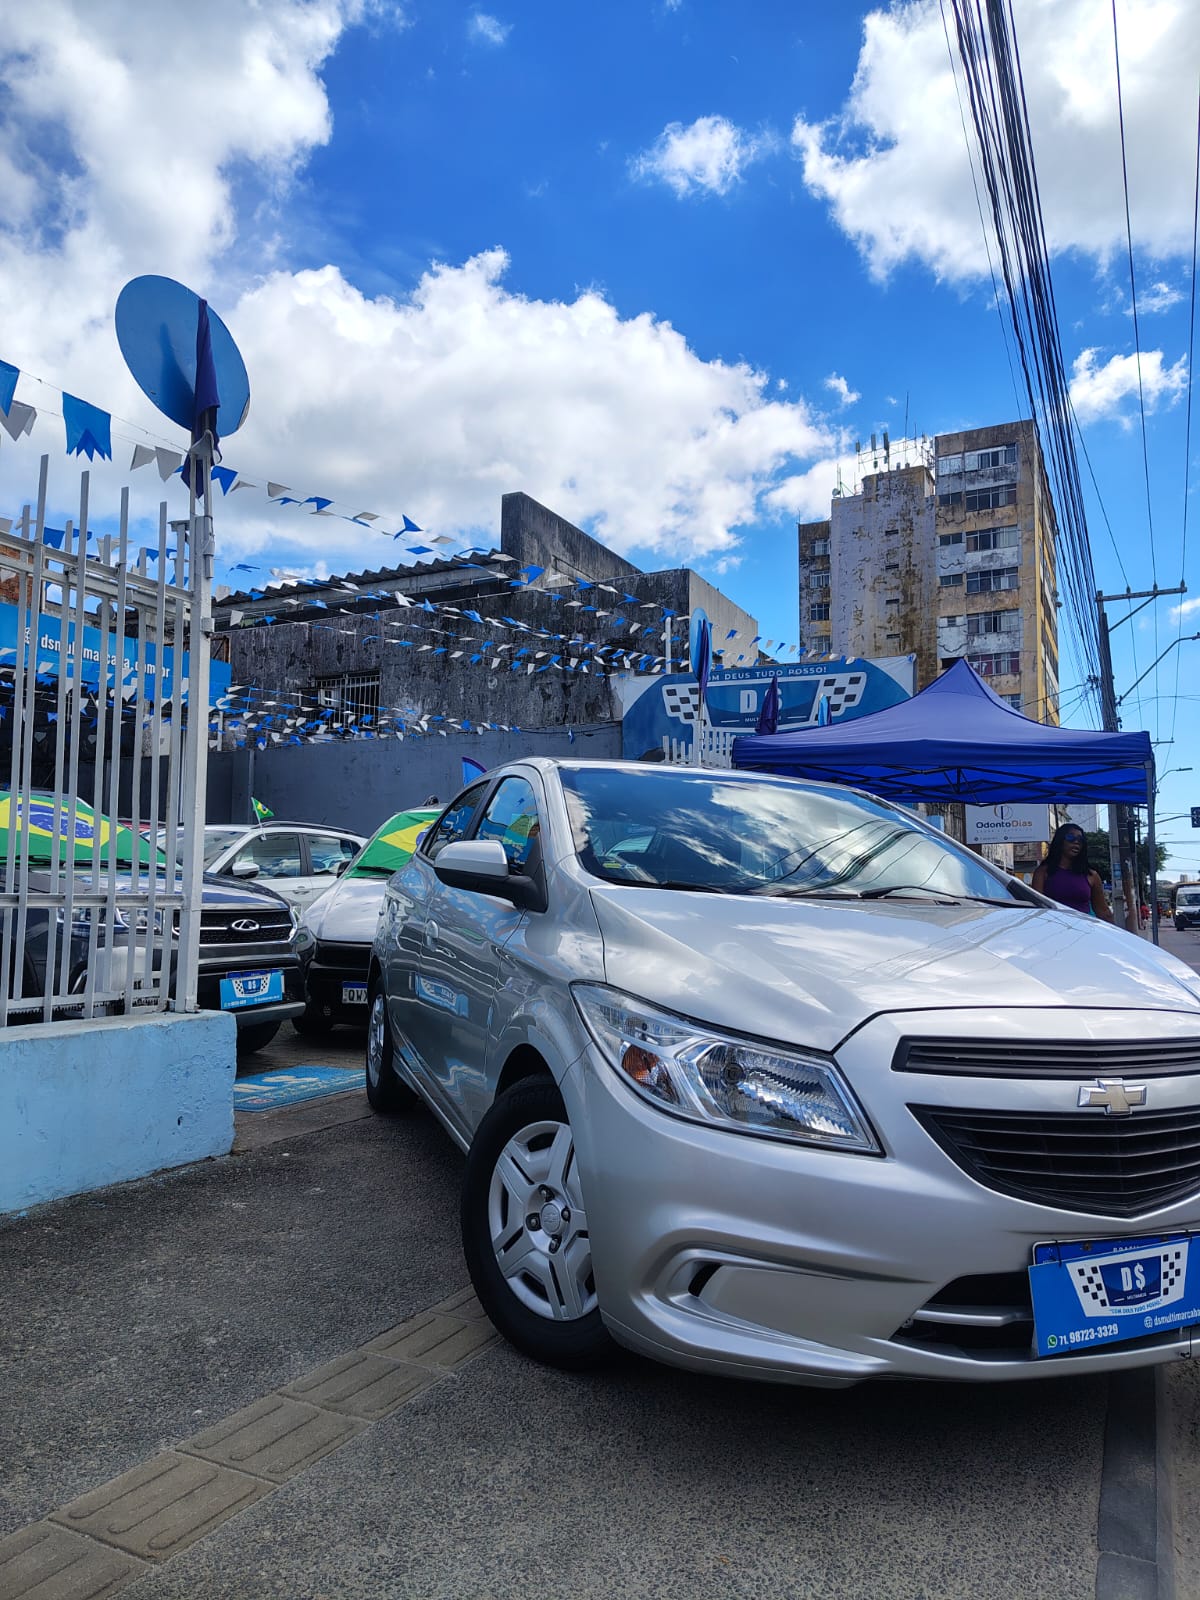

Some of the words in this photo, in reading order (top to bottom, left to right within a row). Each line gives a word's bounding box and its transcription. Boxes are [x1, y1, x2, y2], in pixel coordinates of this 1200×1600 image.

[725, 672, 751, 681] DEUS
[755, 670, 783, 679] TUDO
[976, 820, 1032, 828] OdontoDias
[1069, 1323, 1119, 1344] 98723-3329
